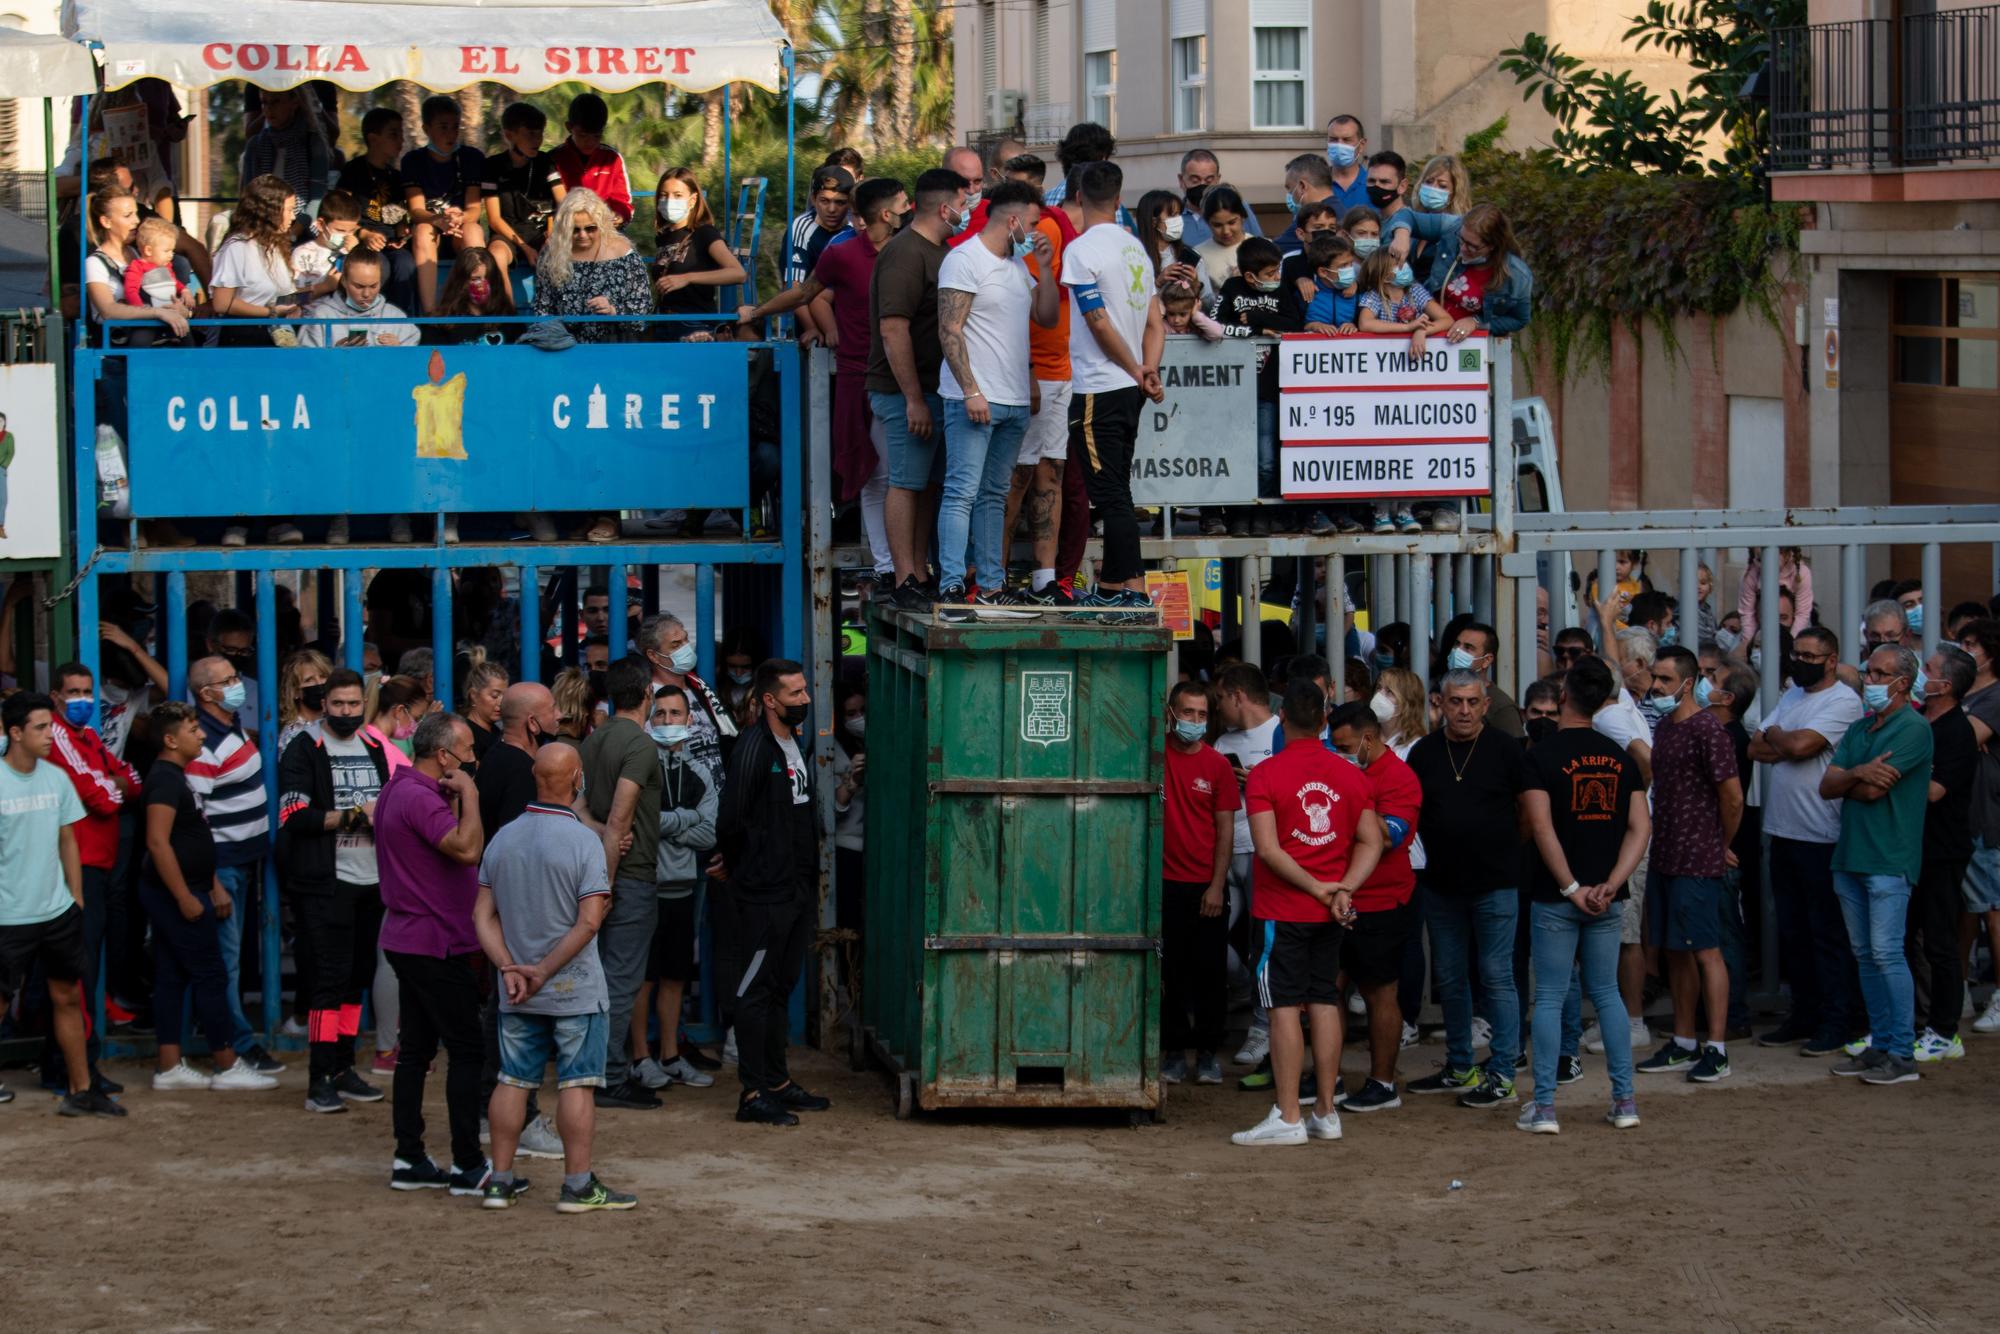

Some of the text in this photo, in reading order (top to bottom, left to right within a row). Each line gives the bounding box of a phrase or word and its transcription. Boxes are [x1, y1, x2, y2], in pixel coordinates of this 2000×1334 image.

[202, 42, 696, 75] COLLA EL SIRET
[1292, 351, 1368, 374] FUENTE
[1376, 350, 1449, 373] YMBRO
[167, 393, 311, 432] COLLA
[1323, 405, 1355, 427] 195
[1374, 403, 1477, 426] MALICIOSO
[1292, 457, 1476, 482] NOVIEMBRE 2015
[1562, 755, 1623, 775] LA KRIPTA
[1296, 782, 1341, 802] BARRERAS
